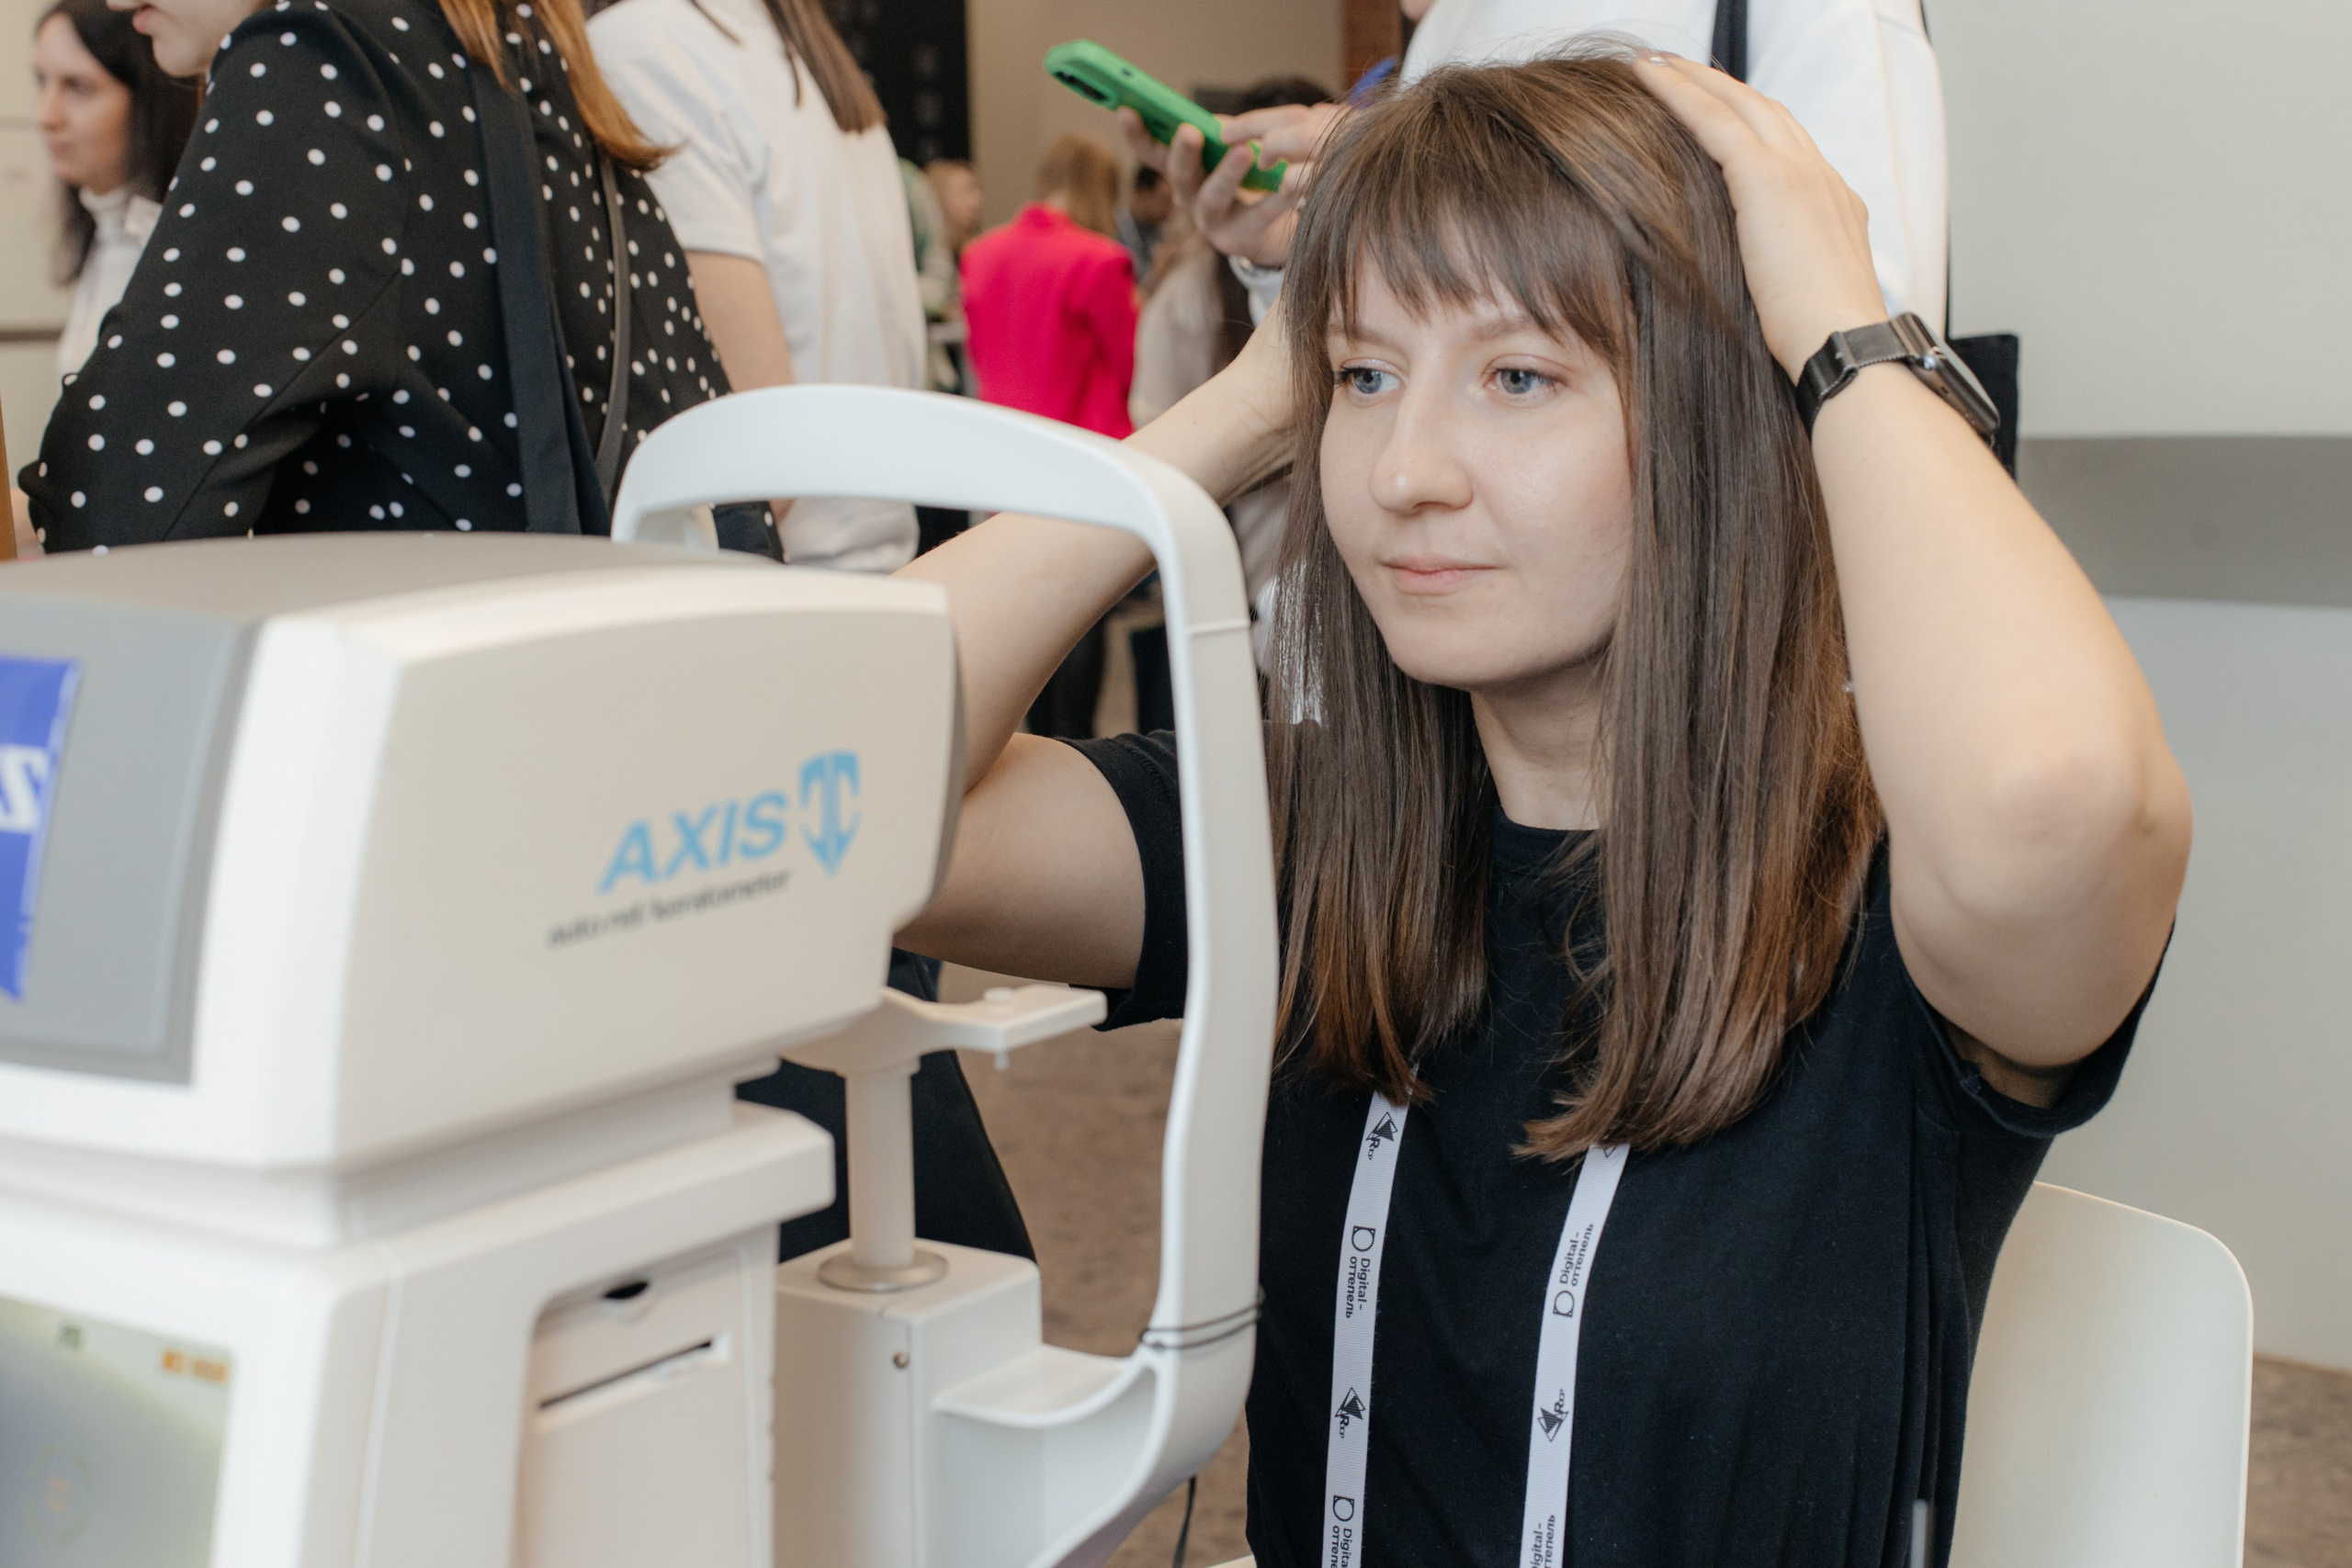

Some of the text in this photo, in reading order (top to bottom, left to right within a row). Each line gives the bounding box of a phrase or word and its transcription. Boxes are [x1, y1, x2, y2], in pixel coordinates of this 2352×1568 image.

[596, 791, 788, 895] AXIS
[1572, 1224, 1593, 1286] оттепель
[1345, 1256, 1358, 1319] оттепель
